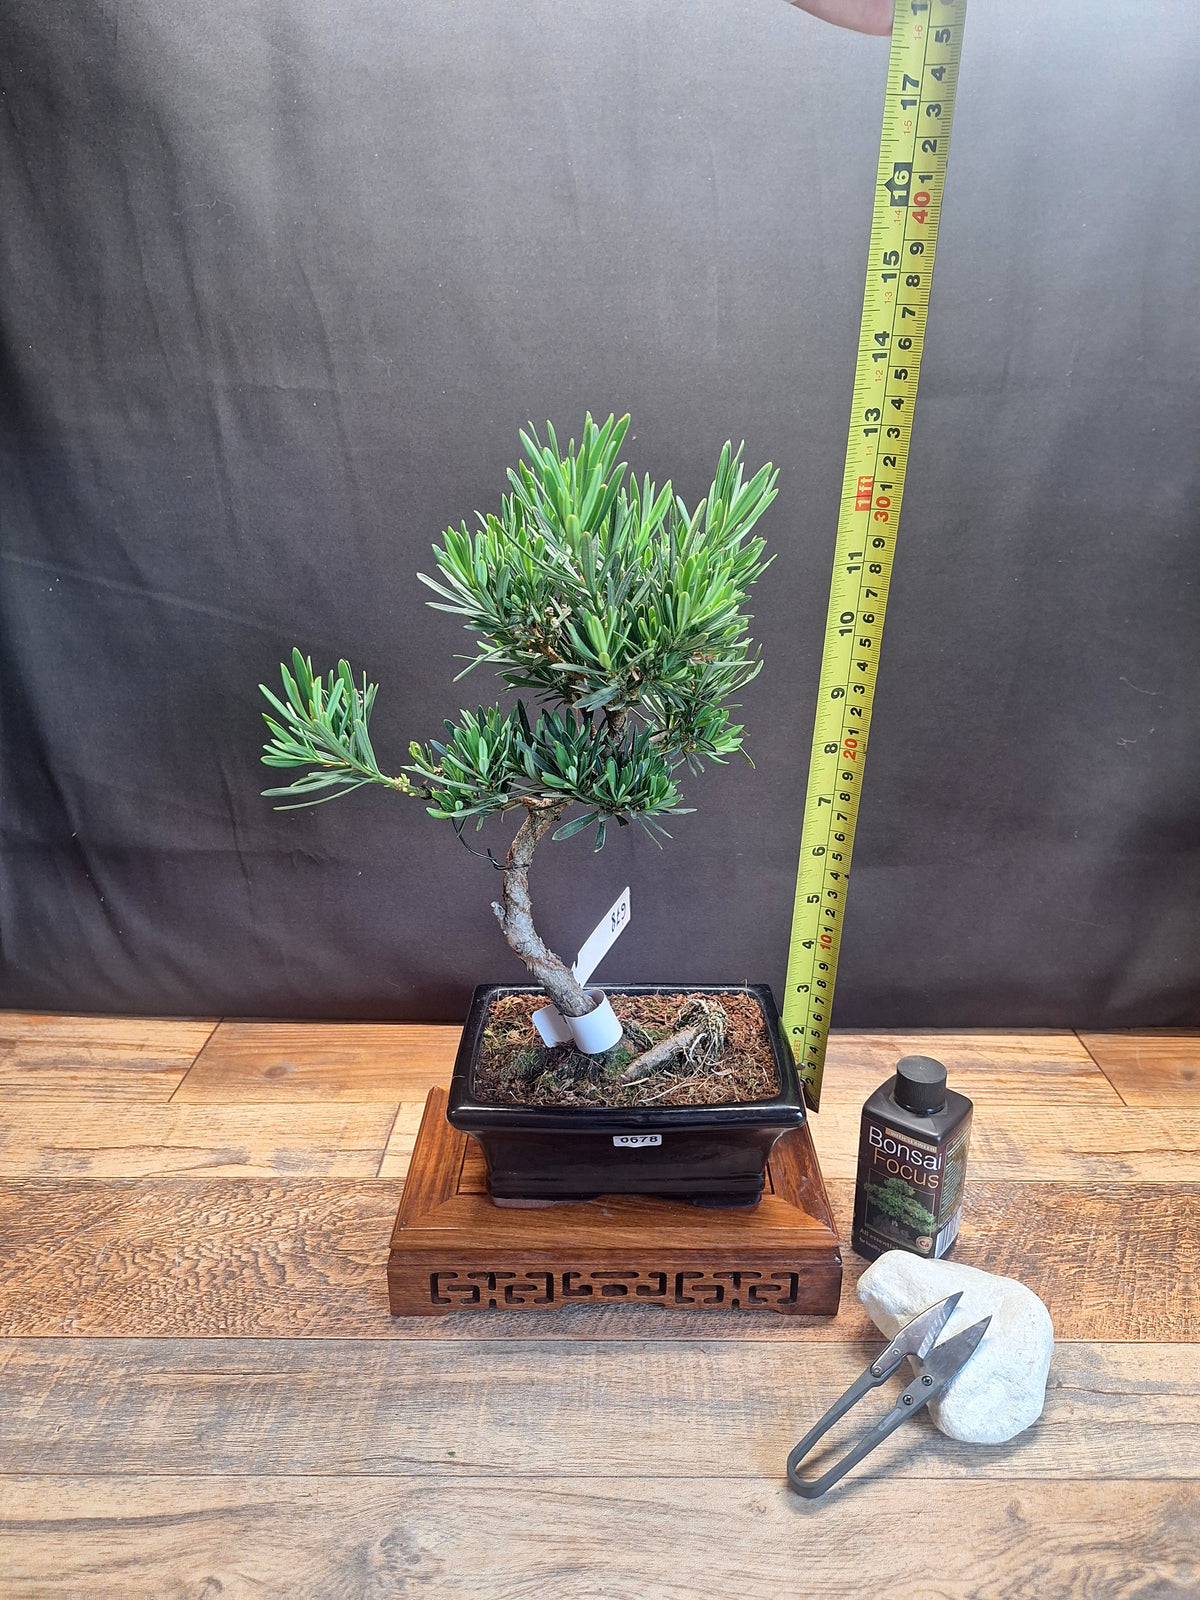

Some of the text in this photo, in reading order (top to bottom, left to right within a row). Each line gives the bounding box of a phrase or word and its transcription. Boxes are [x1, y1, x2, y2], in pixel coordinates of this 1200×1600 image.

[935, 28, 951, 43] 5
[931, 66, 946, 81] 4
[901, 74, 920, 110] 17
[926, 103, 942, 118] 3
[922, 139, 937, 153] 2
[918, 175, 933, 183] 1
[892, 170, 910, 200] 16
[912, 191, 931, 224] 40
[909, 242, 925, 255] 9
[881, 250, 900, 283] 15
[905, 274, 920, 288] 8
[901, 306, 916, 319] 7
[872, 331, 890, 363] 14
[898, 337, 912, 350] 6
[894, 368, 908, 380] 5
[891, 398, 904, 410] 4
[863, 407, 880, 437] 13
[887, 427, 900, 439] 3
[883, 456, 896, 467] 2
[874, 496, 890, 523] 30
[872, 538, 885, 548] 9
[847, 552, 862, 574] 11
[869, 564, 882, 574] 8
[865, 589, 878, 598] 7
[862, 613, 875, 623] 6
[839, 611, 854, 636] 10
[859, 638, 872, 648] 5
[857, 662, 868, 672] 4
[831, 687, 845, 699] 9
[853, 684, 865, 694] 3
[850, 707, 862, 717] 2
[824, 743, 838, 754] 8
[843, 738, 858, 761] 20
[842, 771, 853, 781] 9
[817, 797, 831, 807] 7
[839, 792, 851, 802] 8
[836, 812, 848, 822] 7
[834, 832, 845, 841] 6
[812, 846, 826, 856] 6
[832, 852, 843, 861] 5
[830, 871, 840, 880] 4
[806, 894, 820, 904] 5
[827, 890, 838, 899] 3
[825, 908, 836, 918] 2
[823, 926, 834, 934] 1
[802, 940, 815, 949] 4
[819, 934, 833, 951] 10
[818, 962, 829, 971] 9
[796, 984, 810, 993] 3
[816, 980, 827, 989] 8
[815, 996, 825, 1005] 7
[812, 1013, 823, 1022] 6
[792, 1026, 805, 1035] 2
[811, 1029, 821, 1039] 5
[808, 1045, 819, 1054] 4
[807, 1061, 817, 1071] 3
[620, 1136, 658, 1144] 0678
[869, 1126, 943, 1170] Bonsai
[873, 1147, 940, 1189] Focus
